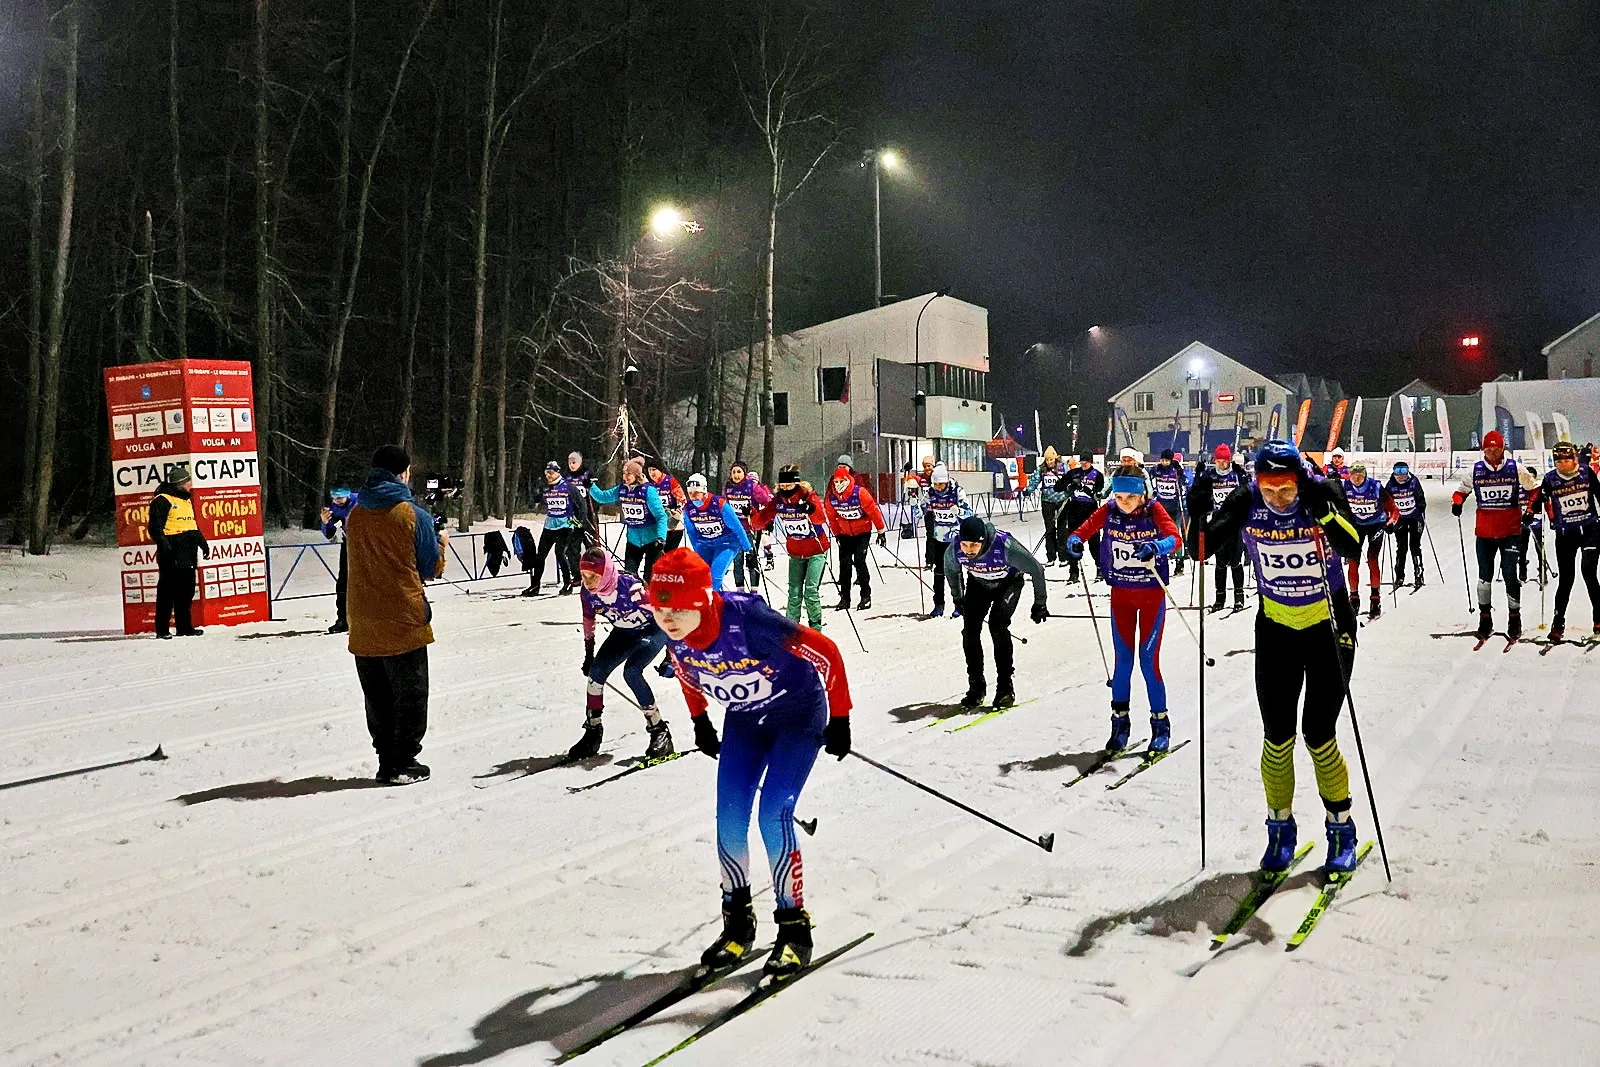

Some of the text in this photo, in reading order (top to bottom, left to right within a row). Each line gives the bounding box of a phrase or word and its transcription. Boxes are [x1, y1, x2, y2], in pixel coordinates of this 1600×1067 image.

[126, 442, 155, 453] VOLGA
[201, 438, 225, 446] VOLGA
[194, 458, 257, 481] СТАРТ
[1482, 490, 1510, 499] 1012
[1562, 495, 1588, 508] 1031
[1260, 550, 1320, 569] 1308
[651, 573, 685, 584] RUSSIA
